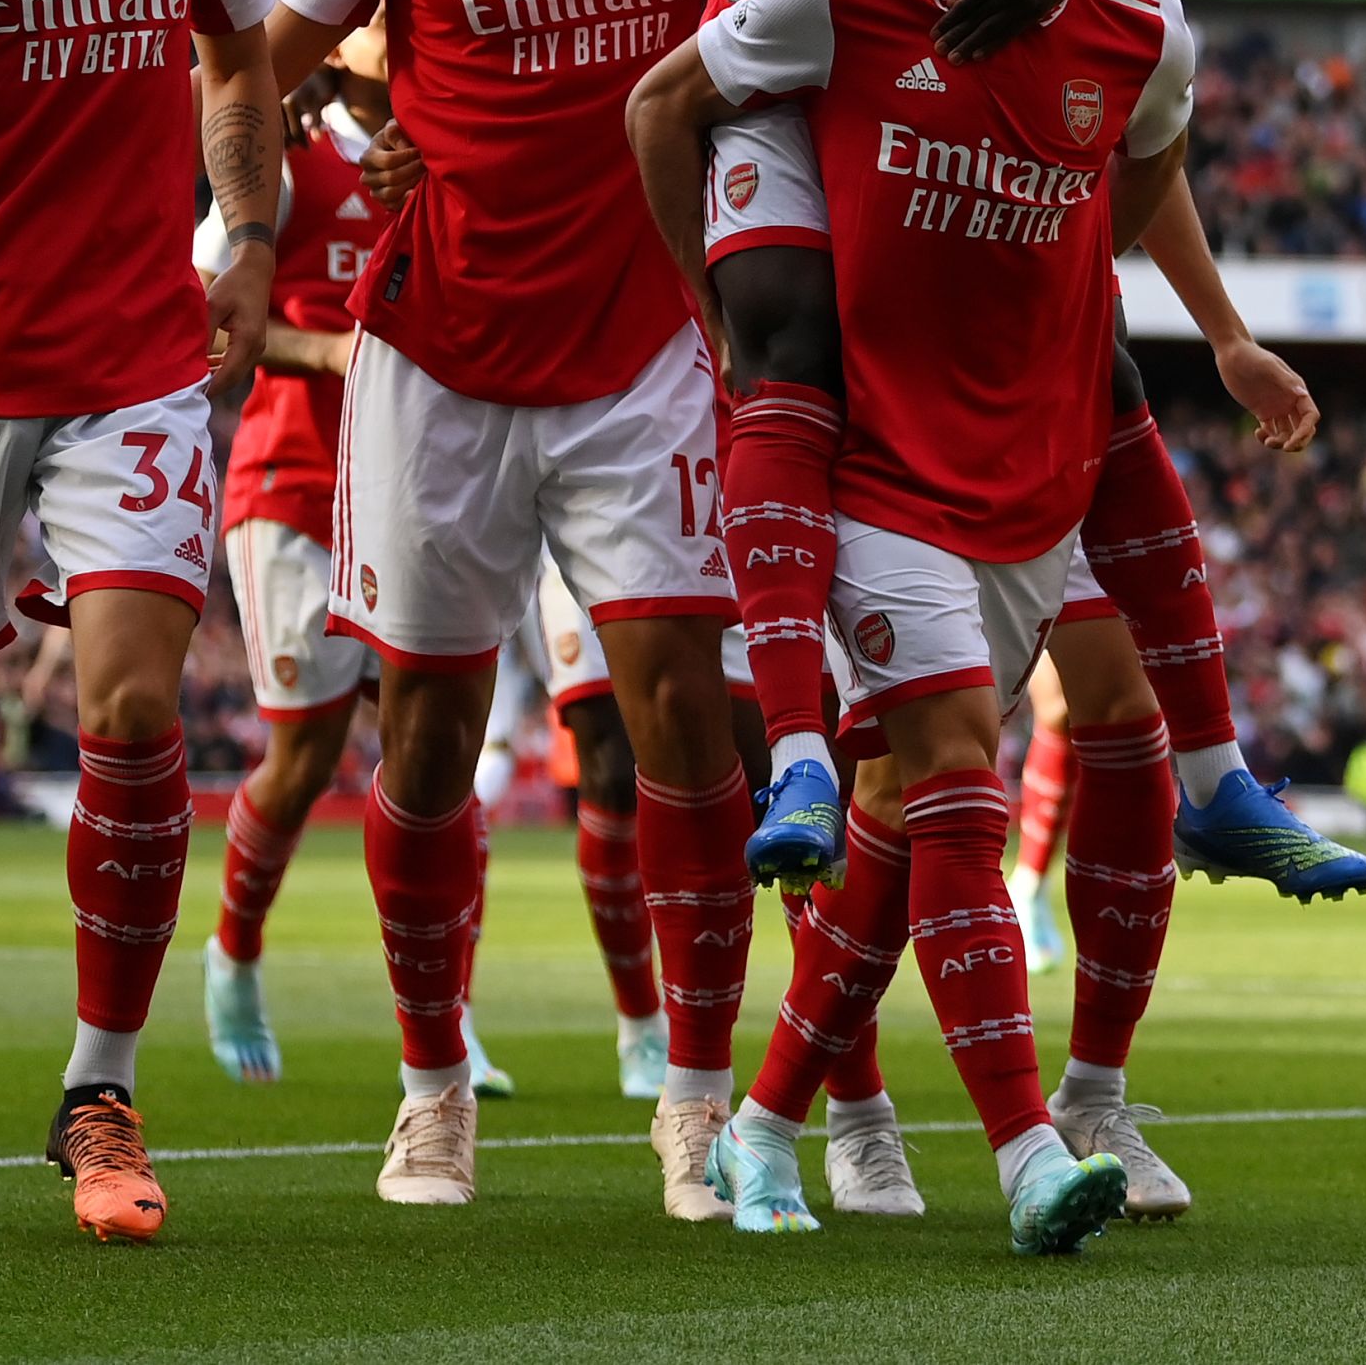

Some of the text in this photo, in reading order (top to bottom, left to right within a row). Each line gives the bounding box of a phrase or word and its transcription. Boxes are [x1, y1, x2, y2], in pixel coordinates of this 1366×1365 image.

[22, 38, 74, 82] FLY
[513, 12, 670, 75] FLY BETTER
[895, 77, 947, 93] adidas
[1068, 90, 1099, 101] Arsenal
[877, 121, 1095, 205] Emirates
[903, 188, 1068, 244] FLY BETTER
[119, 431, 212, 531] 34
[671, 453, 723, 538] 12
[746, 545, 816, 570] AFC
[96, 858, 181, 880] AFC
[1097, 905, 1170, 929] AFC
[940, 946, 1014, 979] AFC
